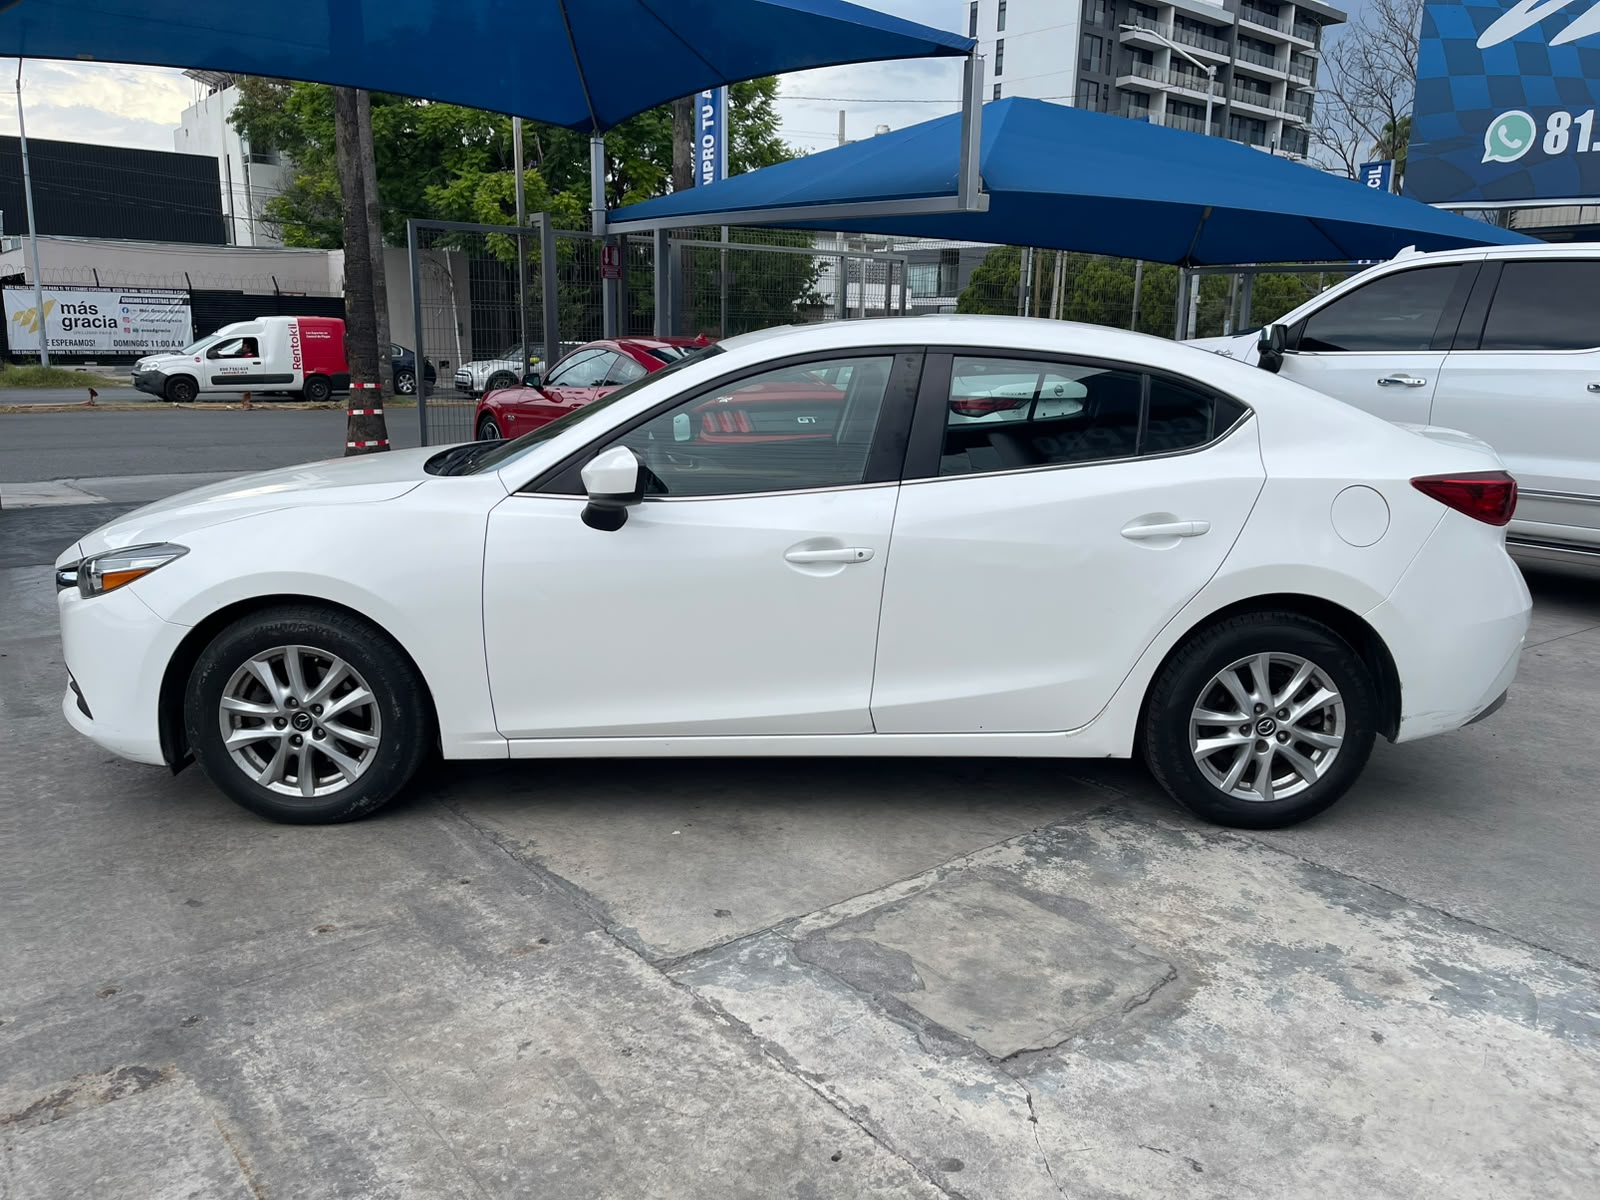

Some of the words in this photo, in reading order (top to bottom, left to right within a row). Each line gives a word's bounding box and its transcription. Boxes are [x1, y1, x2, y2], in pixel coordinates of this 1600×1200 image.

[702, 104, 714, 130] TU
[1367, 165, 1383, 190] CIL
[60, 301, 98, 315] más
[62, 315, 118, 331] gracia
[51, 339, 96, 347] ESPERAMOS!
[287, 323, 301, 370] Rentokil
